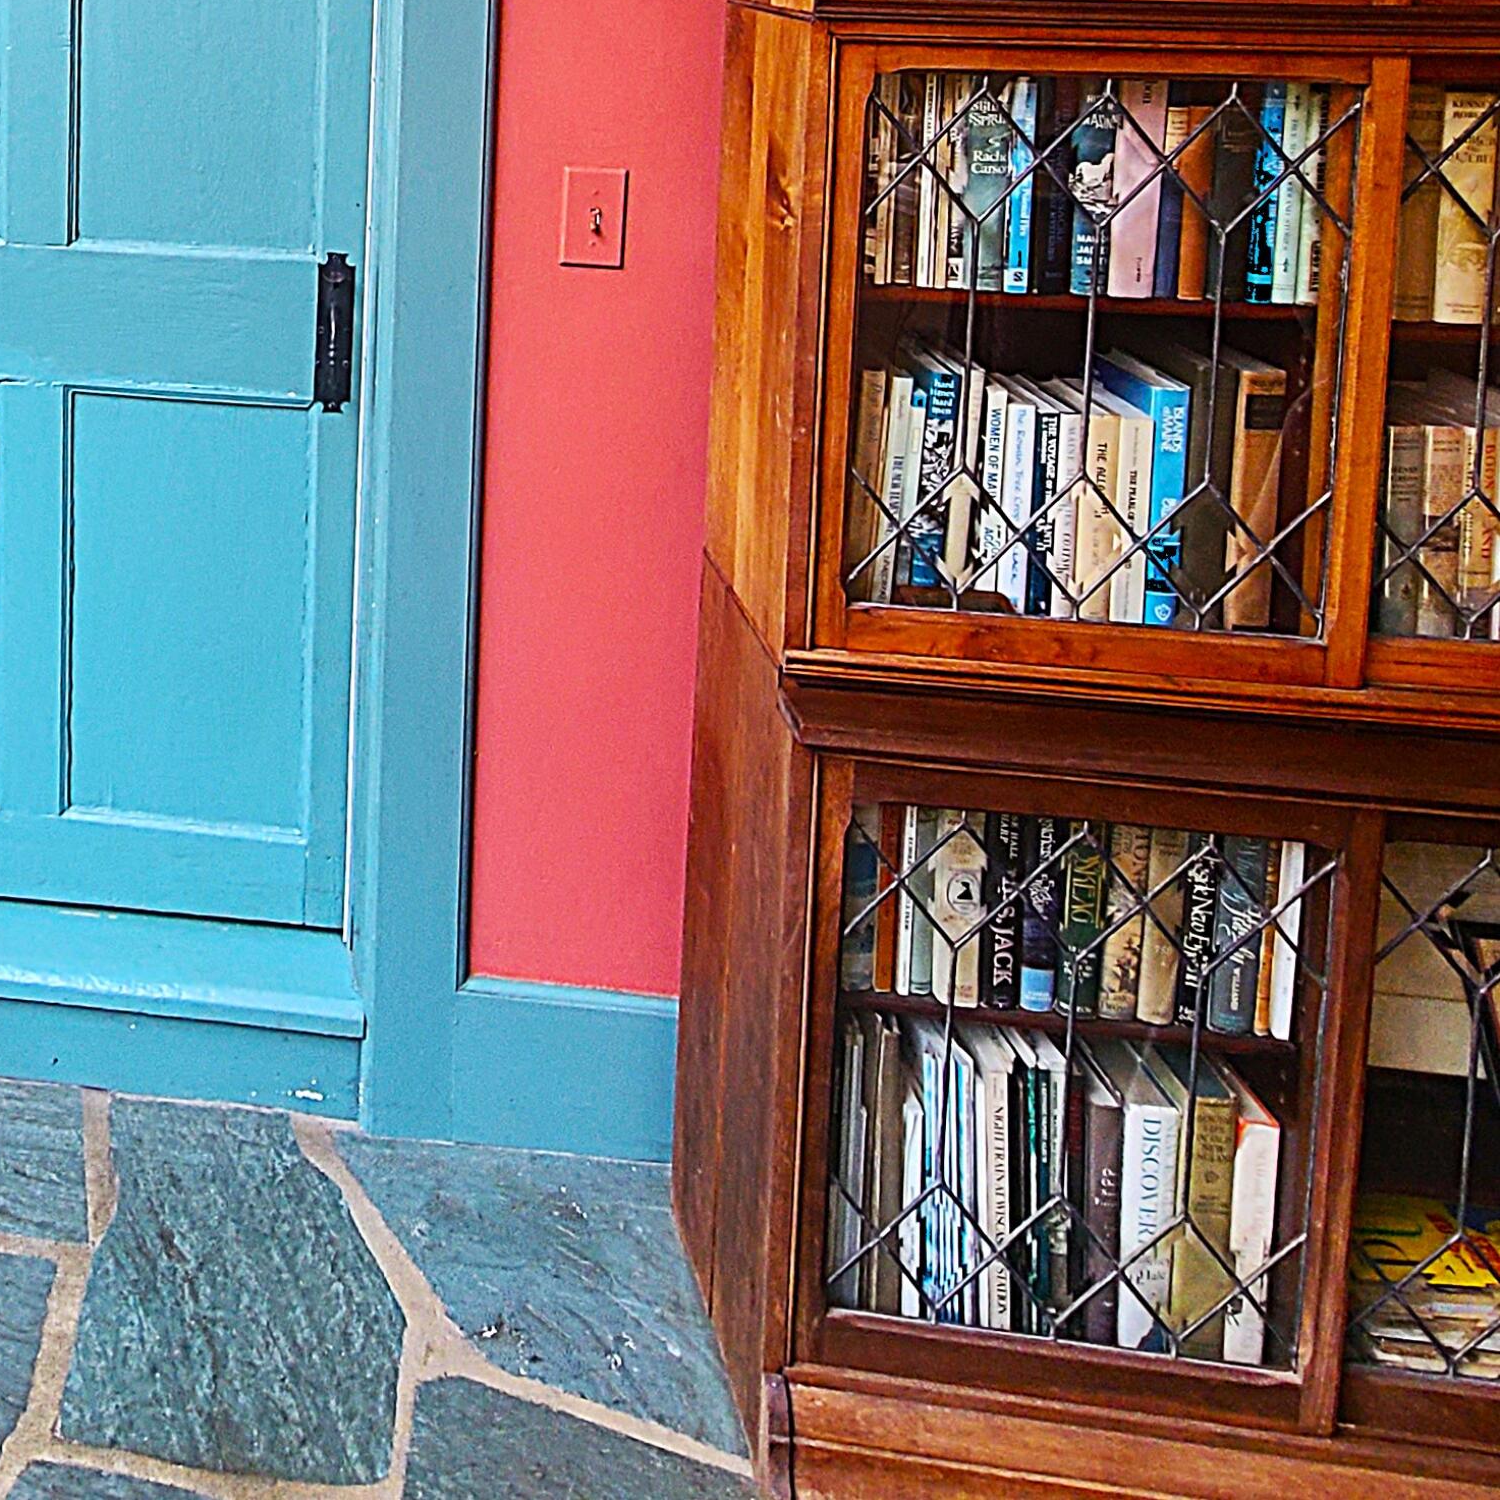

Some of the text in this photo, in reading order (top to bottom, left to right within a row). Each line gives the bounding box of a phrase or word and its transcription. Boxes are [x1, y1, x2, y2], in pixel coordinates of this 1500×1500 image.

[1048, 416, 1058, 437] THE
[1161, 414, 1175, 452] MAINE
[1172, 407, 1186, 453] ISLANDS
[985, 408, 1003, 500] WOMEN OF MAI
[1046, 438, 1057, 479] VOYAGE
[1096, 443, 1107, 462] THE
[1485, 444, 1497, 490] BOON
[1130, 470, 1138, 485] THE
[1127, 511, 1136, 521] OF
[1128, 486, 1138, 511] PEARL
[1009, 831, 1019, 860] HALL
[989, 924, 1015, 987] JACK
[1138, 1118, 1162, 1245] DISCOVER
[994, 1106, 1007, 1315] NIGHT TRAIN AT WISCAS STATION
